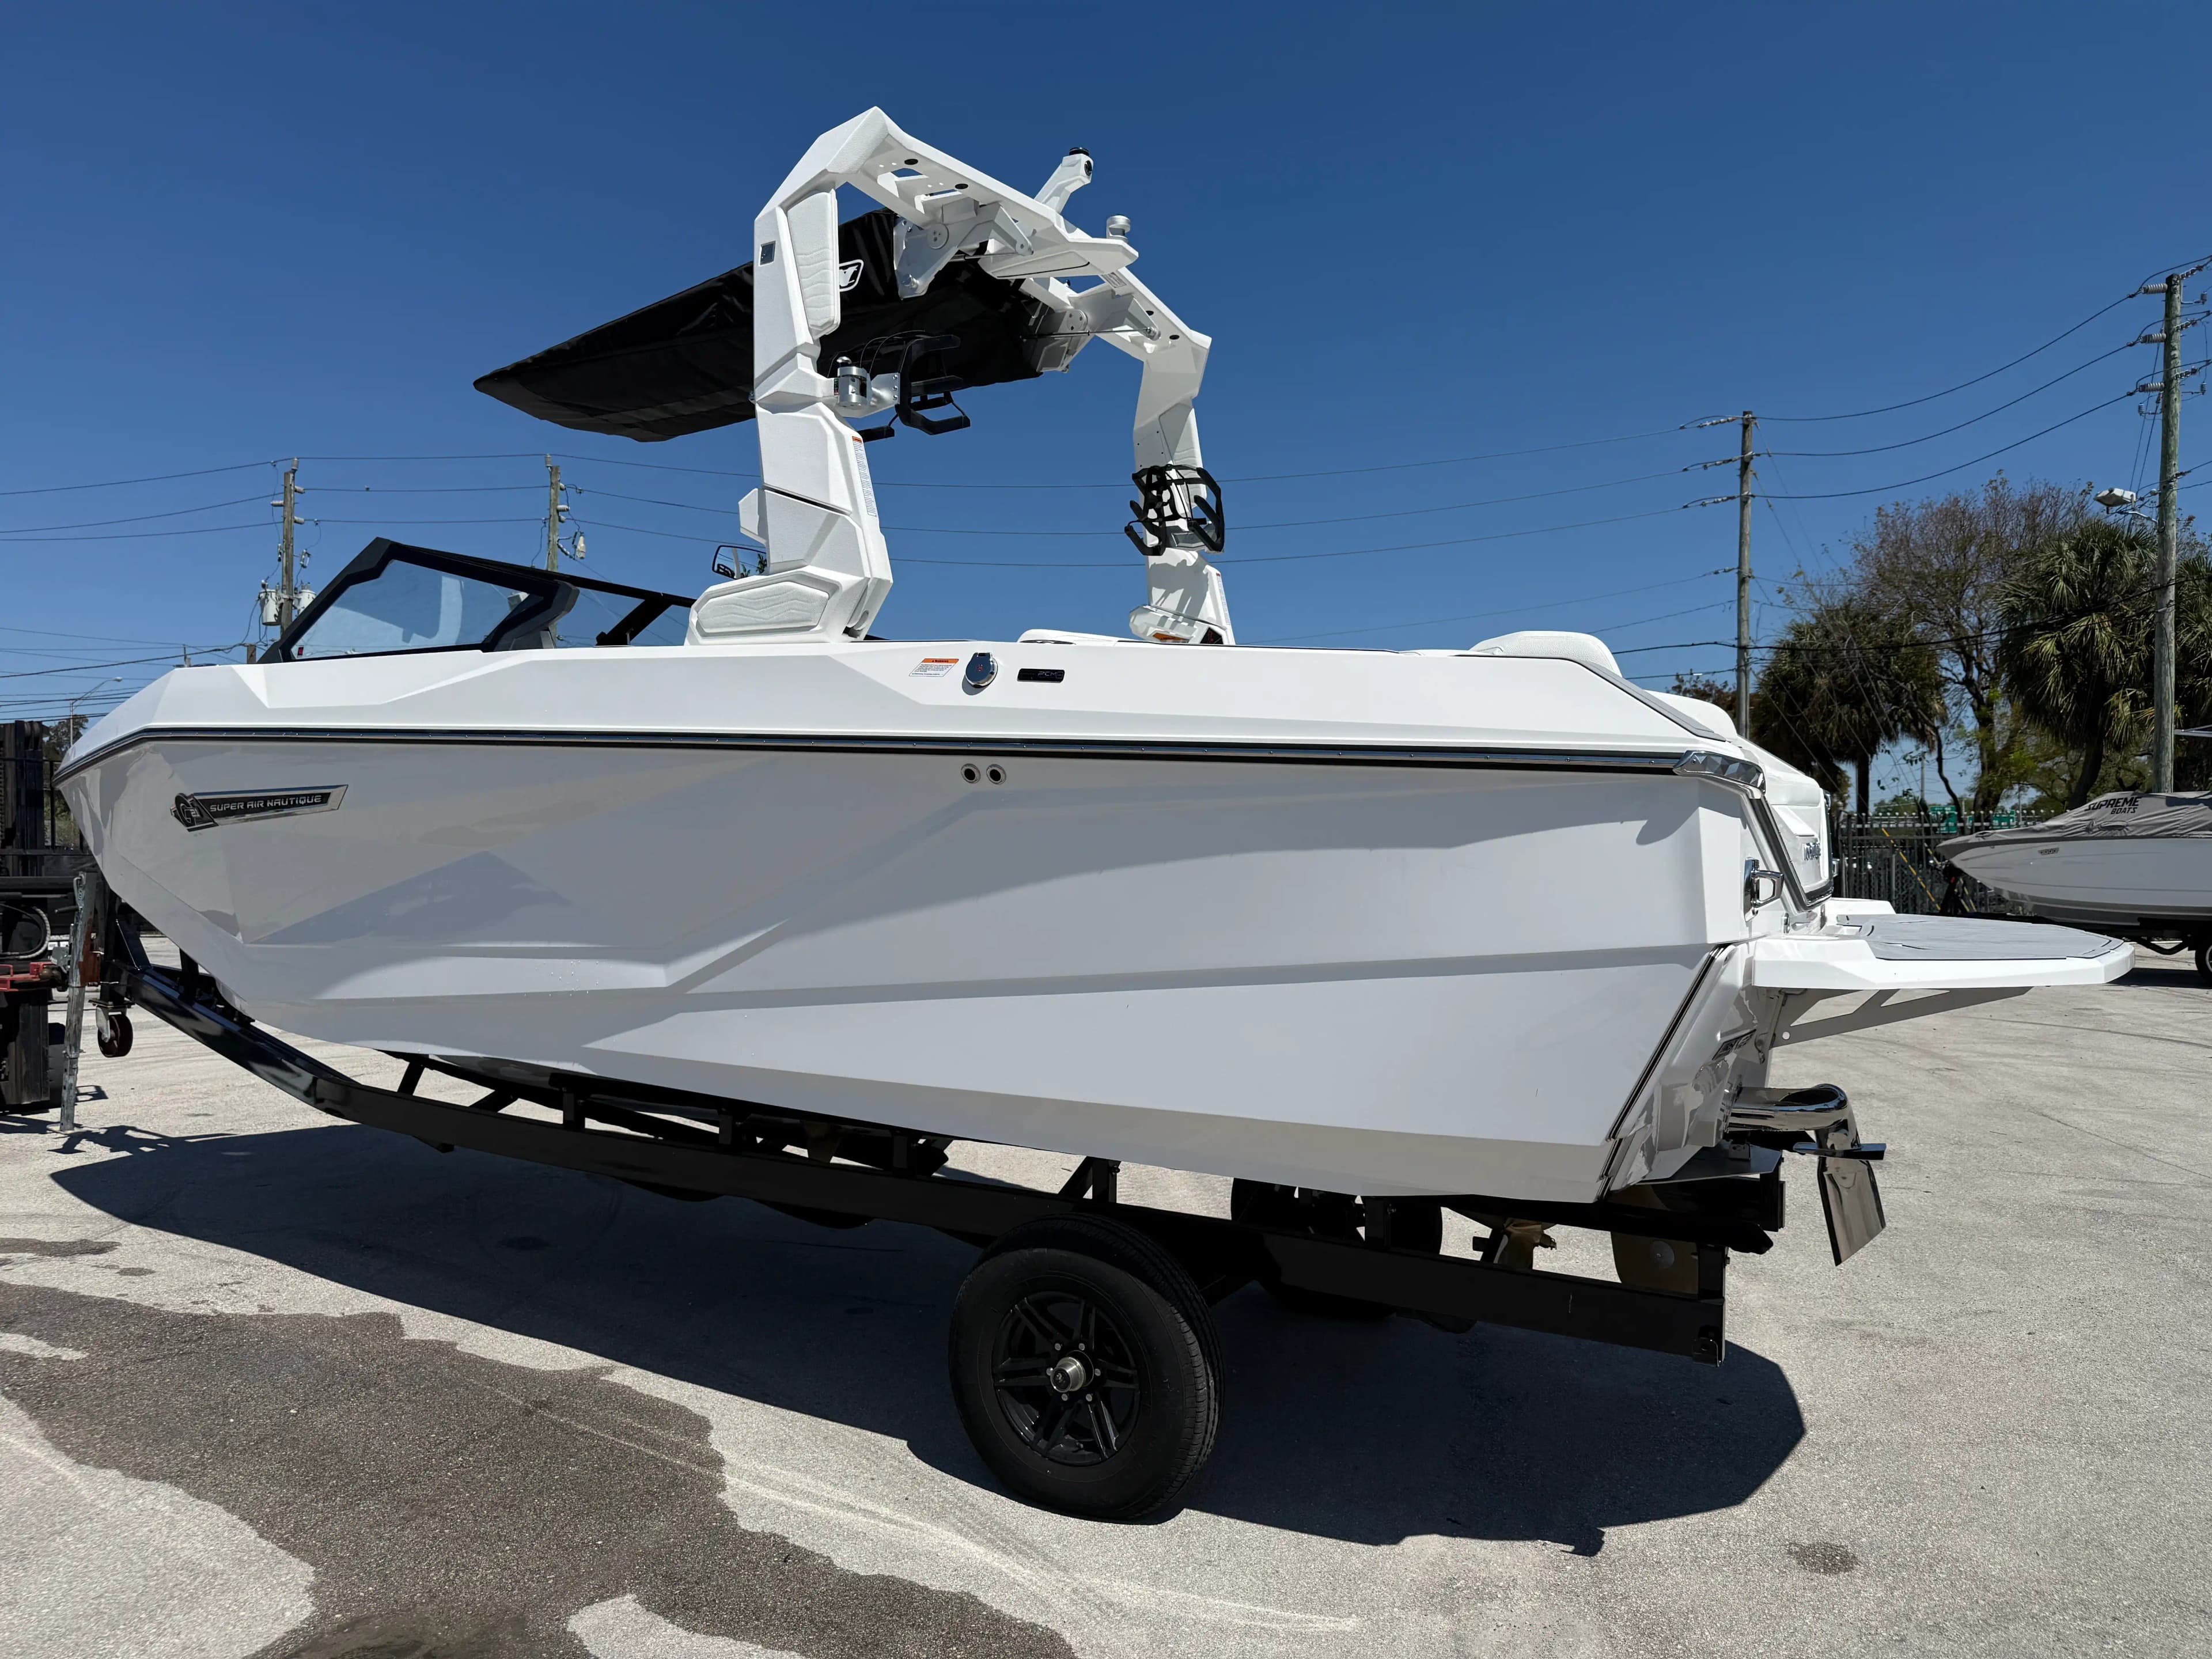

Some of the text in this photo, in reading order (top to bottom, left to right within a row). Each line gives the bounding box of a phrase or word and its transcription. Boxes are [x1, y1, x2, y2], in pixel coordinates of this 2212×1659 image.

[210, 795, 322, 812] SUPER AIR NAUTIQUE
[2084, 796, 2142, 812] SUPREME
[2110, 806, 2138, 815] BOATS
